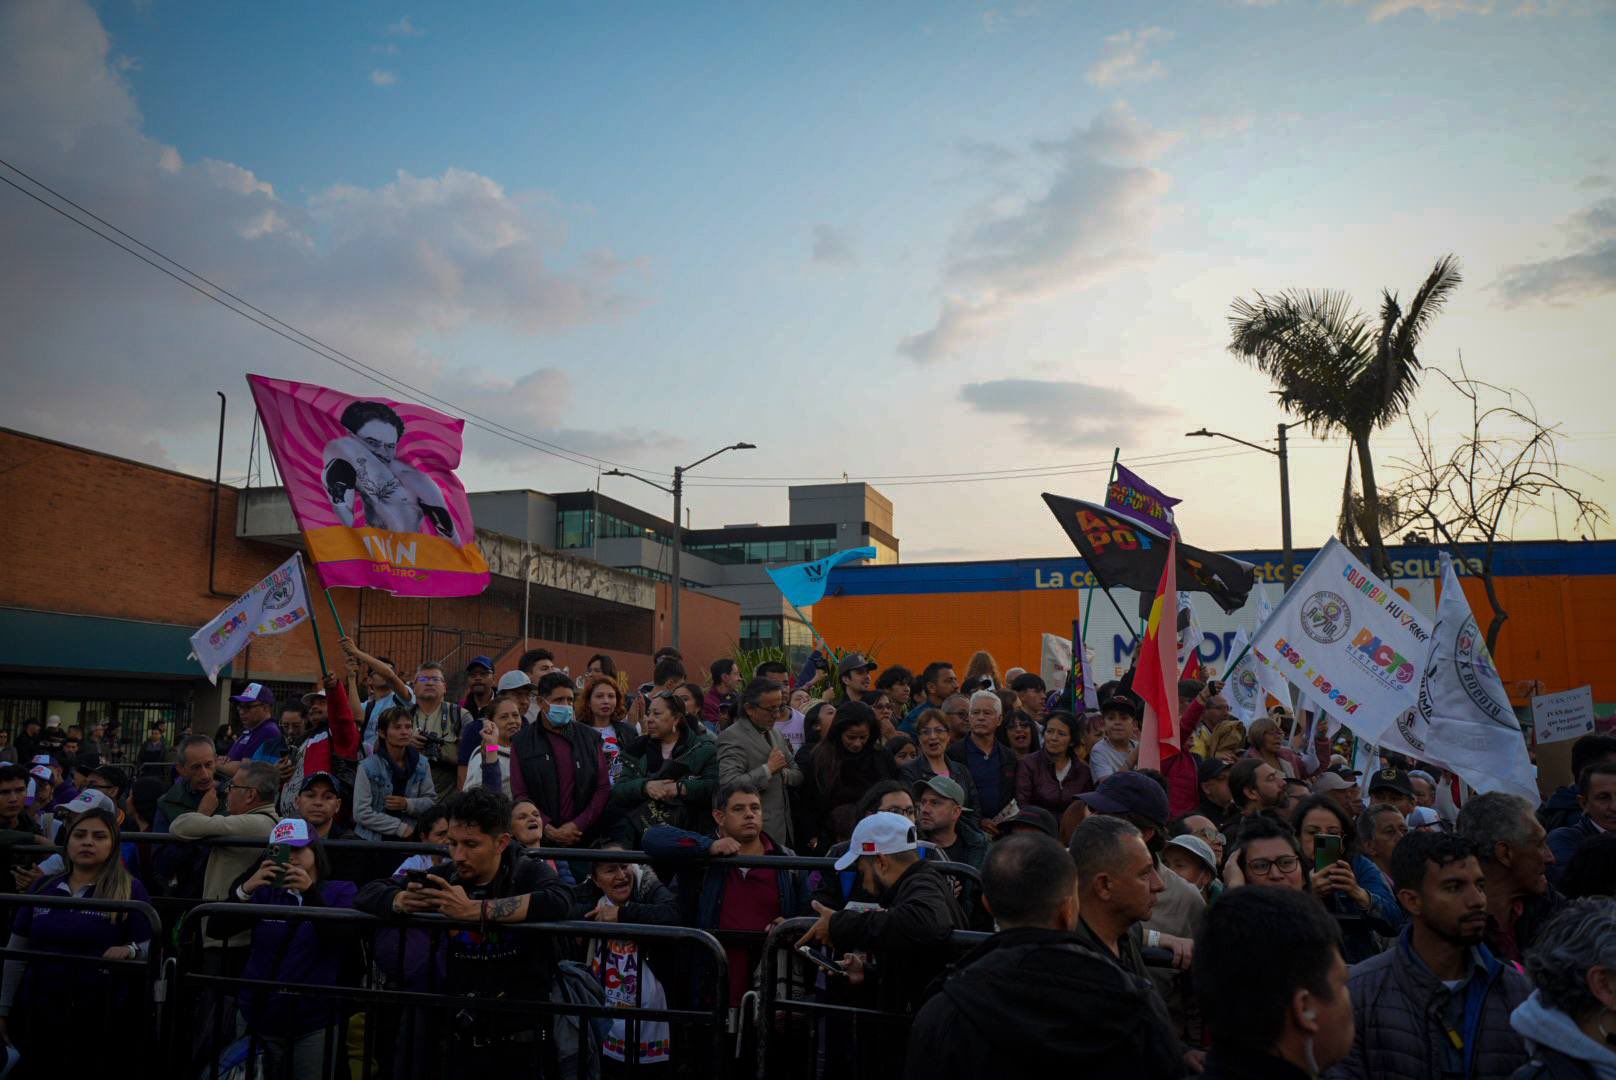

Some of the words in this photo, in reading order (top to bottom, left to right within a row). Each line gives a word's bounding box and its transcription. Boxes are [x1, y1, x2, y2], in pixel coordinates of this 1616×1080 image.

[1035, 568, 1064, 588] La
[1343, 564, 1389, 605] COLOMBIA
[1274, 638, 1306, 670] BESOS
[1312, 674, 1362, 715] BOGOTÁ
[1352, 627, 1414, 684] PACTO
